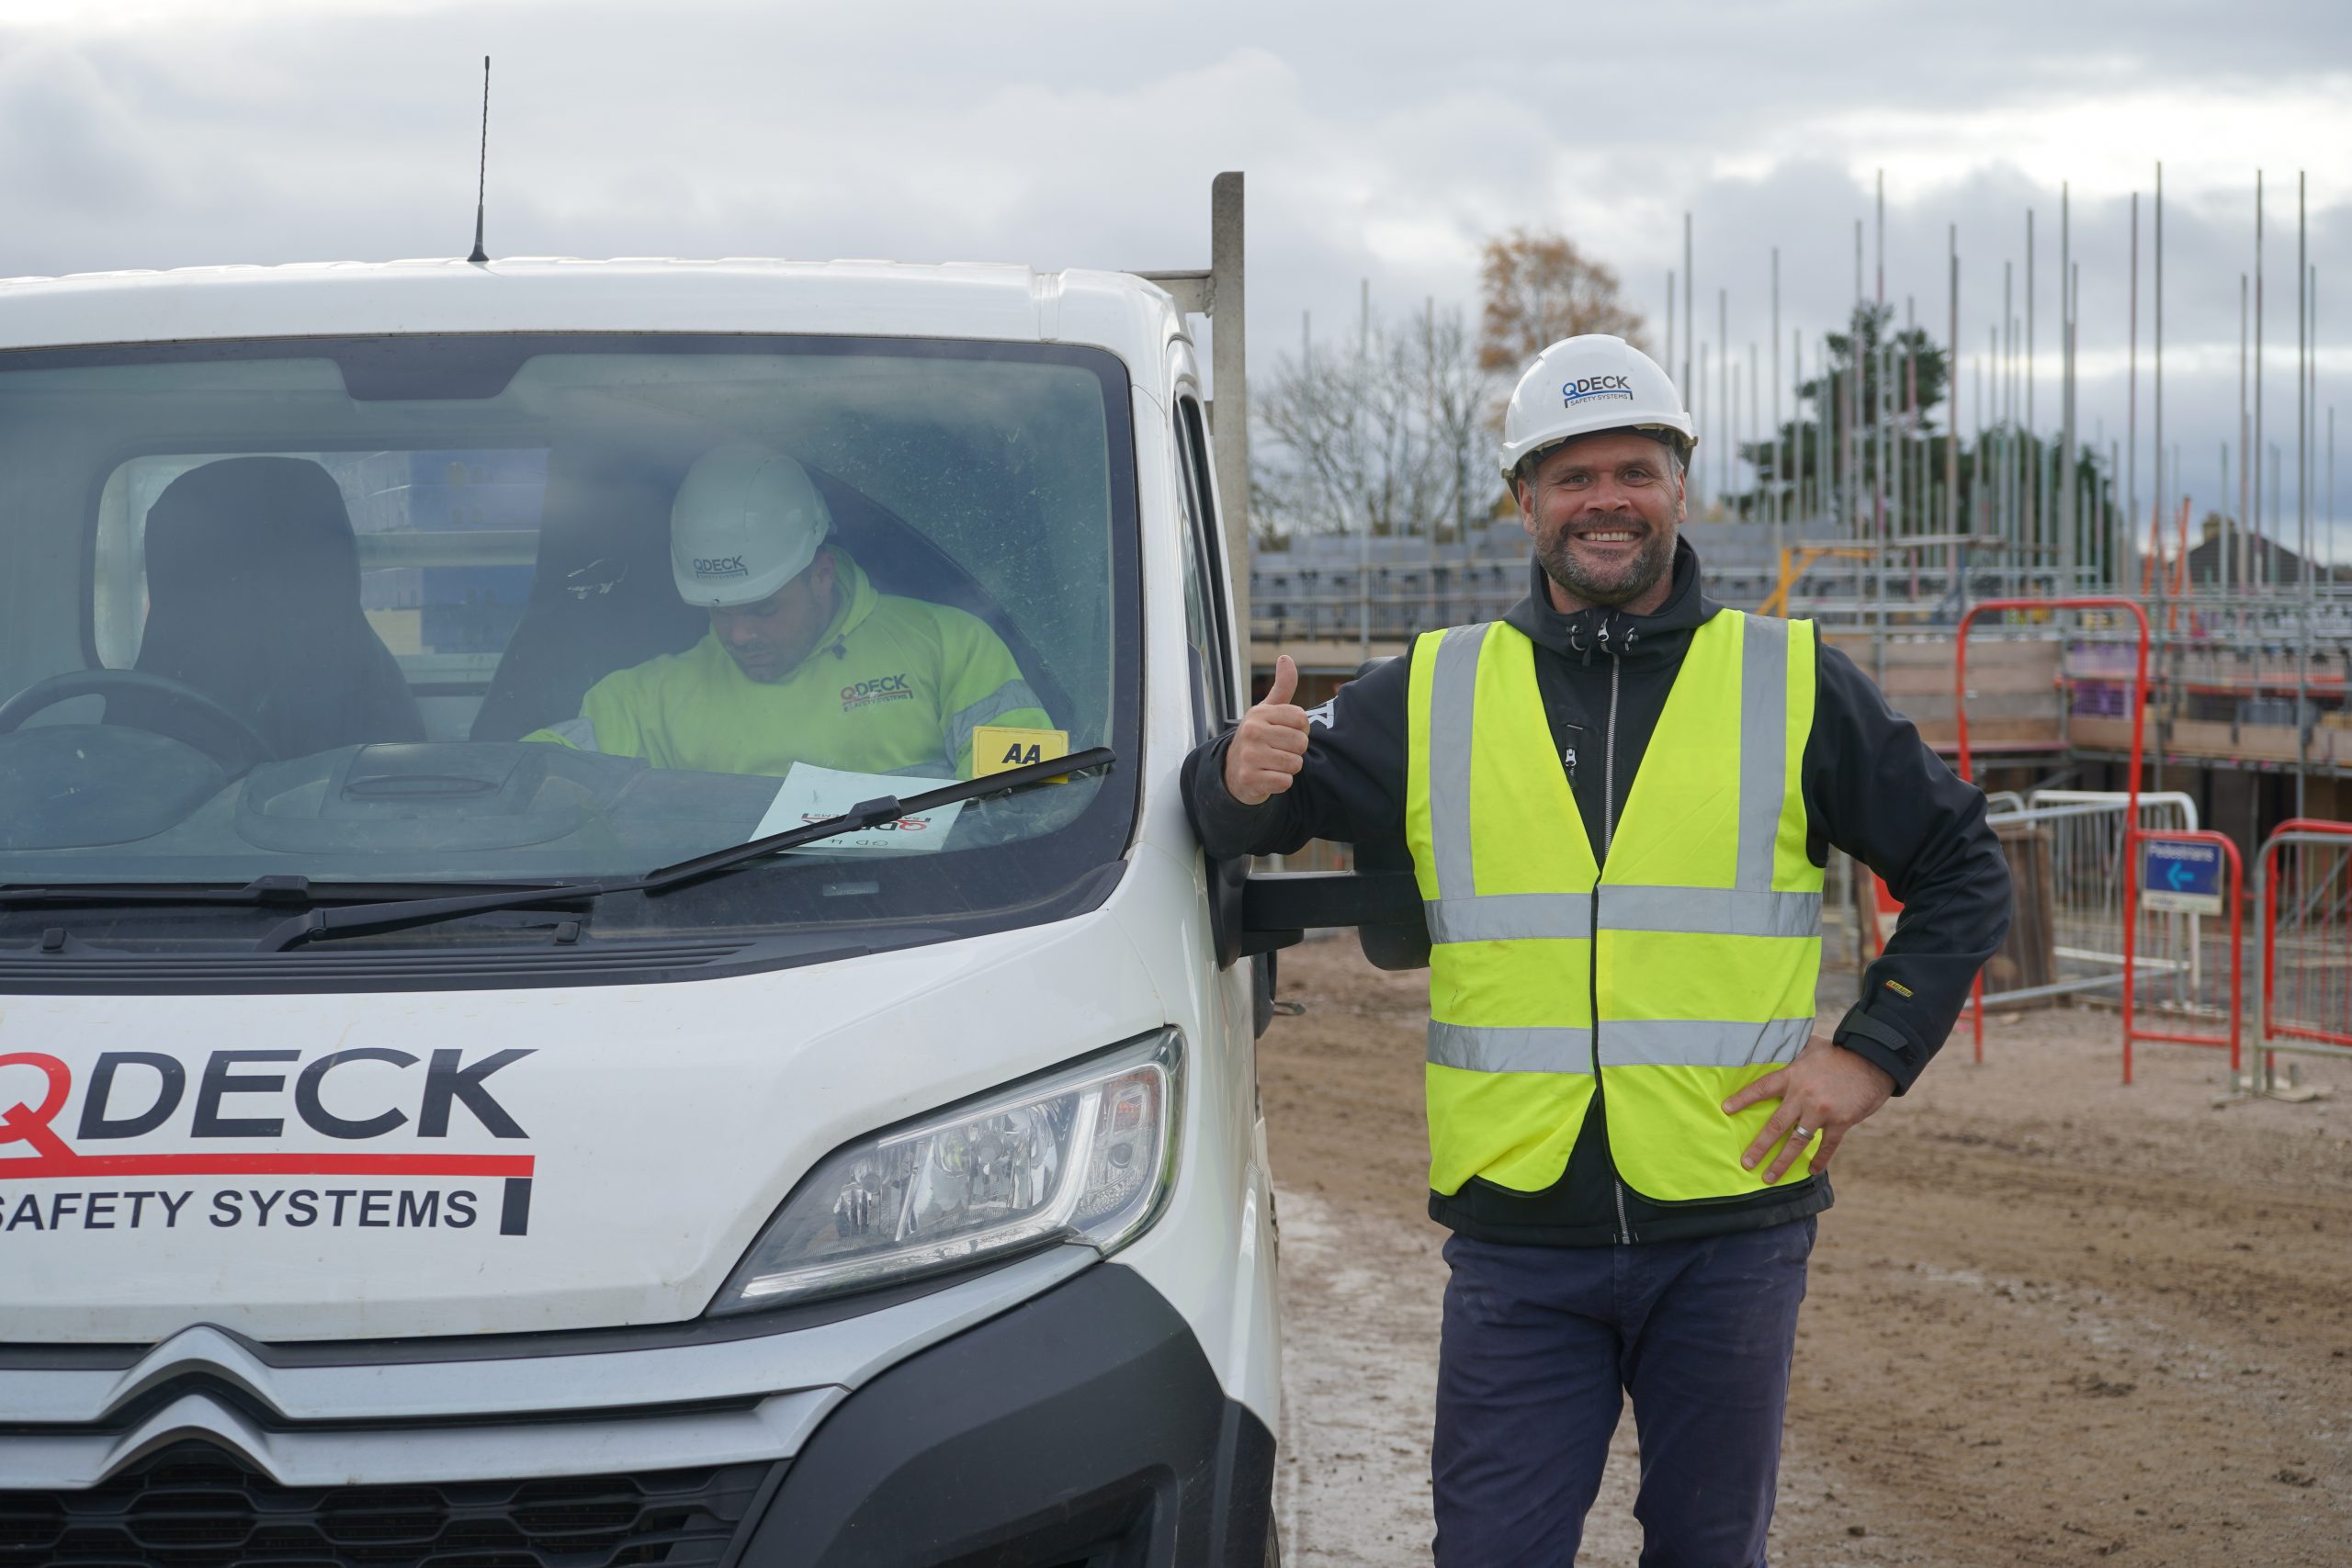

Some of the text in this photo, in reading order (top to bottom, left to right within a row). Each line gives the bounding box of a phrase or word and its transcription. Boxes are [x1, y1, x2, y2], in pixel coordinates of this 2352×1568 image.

[1563, 376, 1631, 397] QDECK
[1570, 396, 1596, 406] SAFETY
[694, 555, 745, 573] QDECK
[841, 673, 909, 700] QDECK
[1001, 743, 1040, 764] AA
[0, 1047, 539, 1156] QDECK
[0, 1190, 478, 1230] AFETY SYSTEMS
